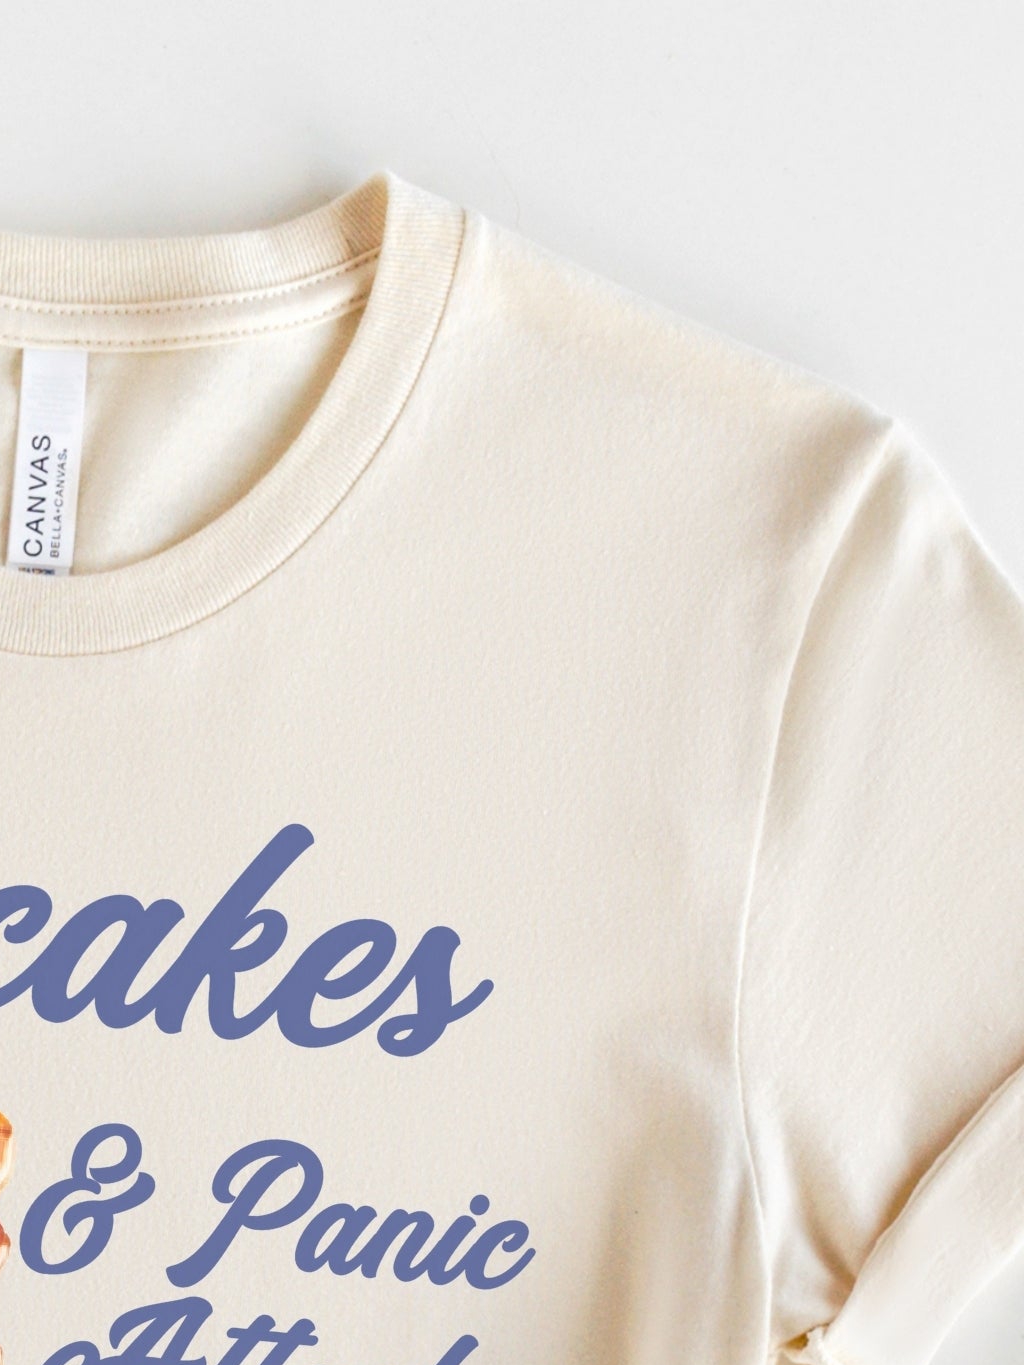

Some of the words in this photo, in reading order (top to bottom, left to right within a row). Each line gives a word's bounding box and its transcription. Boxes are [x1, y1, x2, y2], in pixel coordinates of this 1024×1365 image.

[23, 435, 51, 558] CANVAS
[20, 1123, 156, 1275] &
[166, 1139, 536, 1290] Panic
